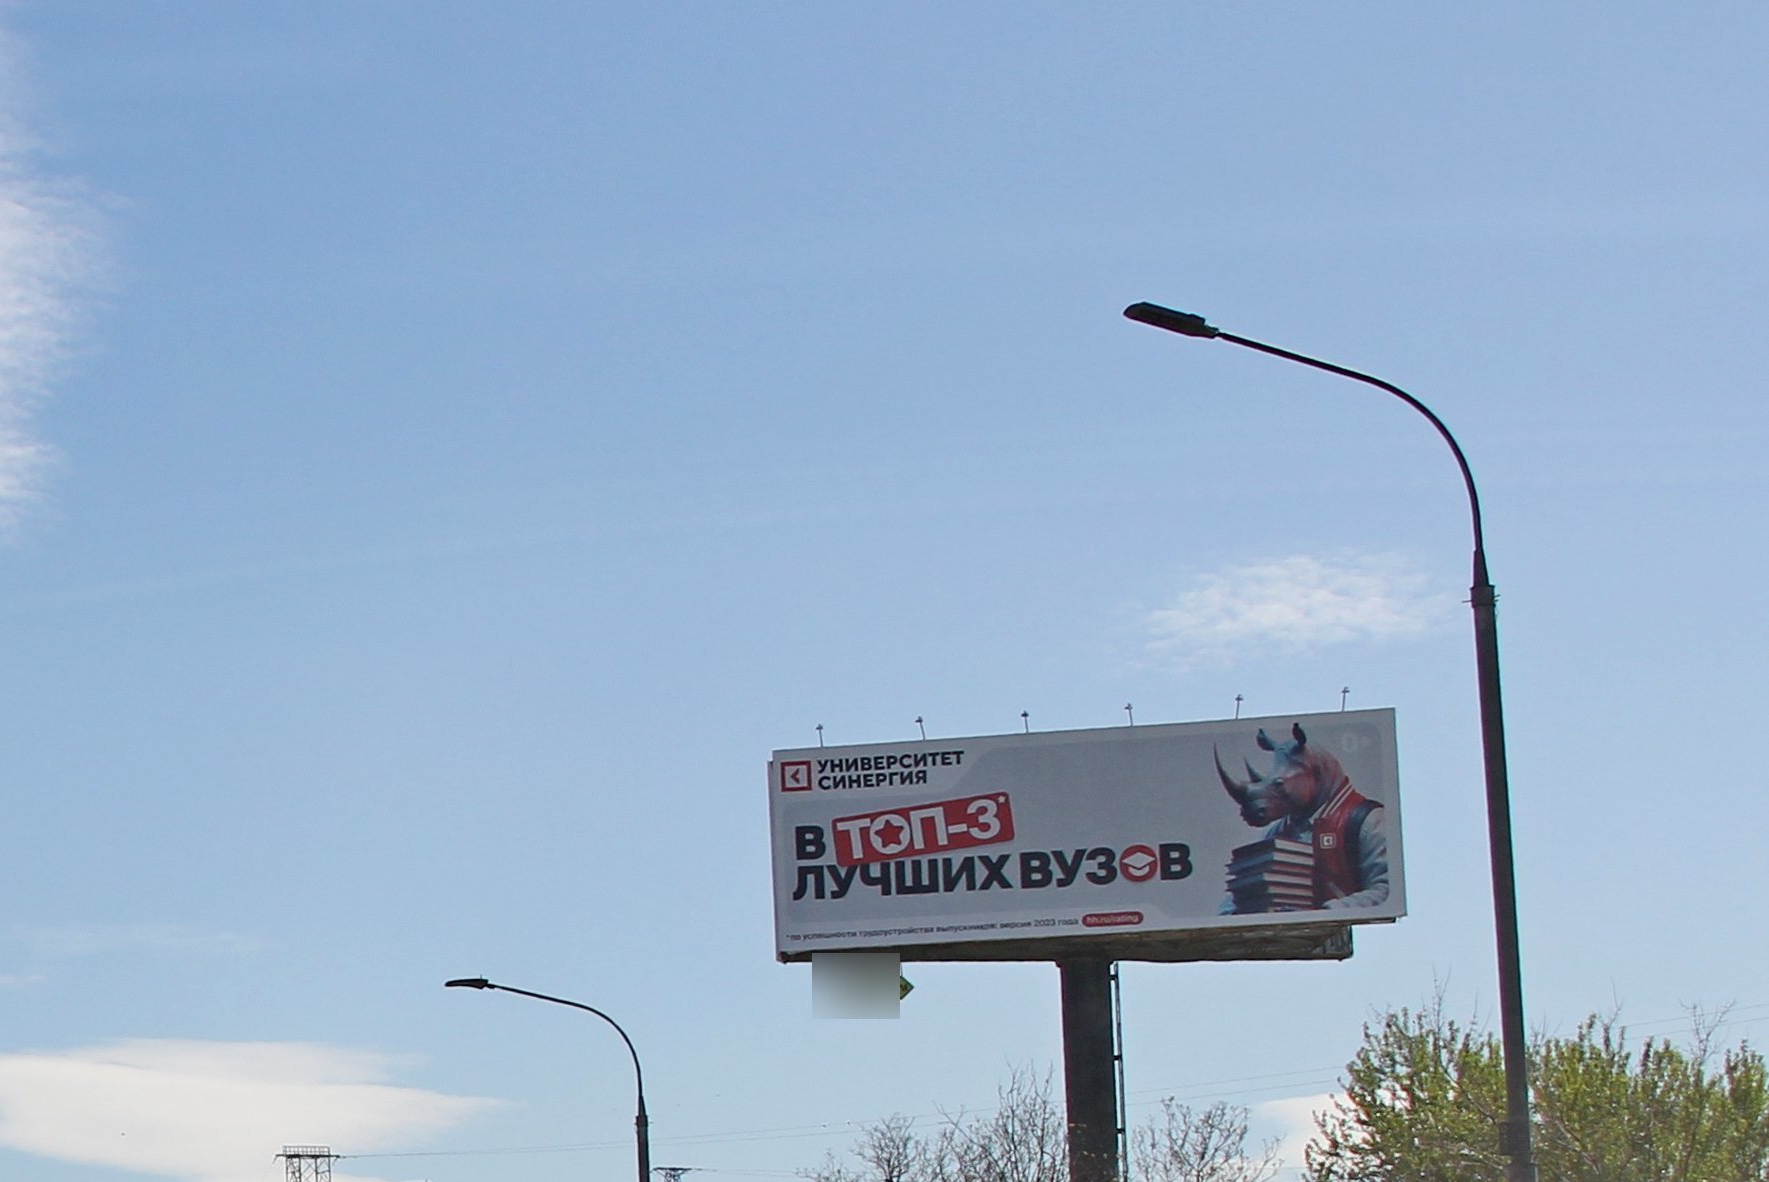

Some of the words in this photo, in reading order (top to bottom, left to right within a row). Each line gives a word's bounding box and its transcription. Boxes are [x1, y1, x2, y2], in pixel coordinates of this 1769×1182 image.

[817, 751, 965, 774] УНИВЕРСИТЕТ
[818, 769, 927, 790] СИНЕРГИЯ
[795, 825, 826, 860] В
[793, 854, 1014, 901] ЛУЧШИХ
[1020, 843, 1193, 890] ВУЗОВ
[859, 926, 934, 938] трудоустройства
[1034, 919, 1056, 927] 2023
[1058, 919, 1079, 927] года
